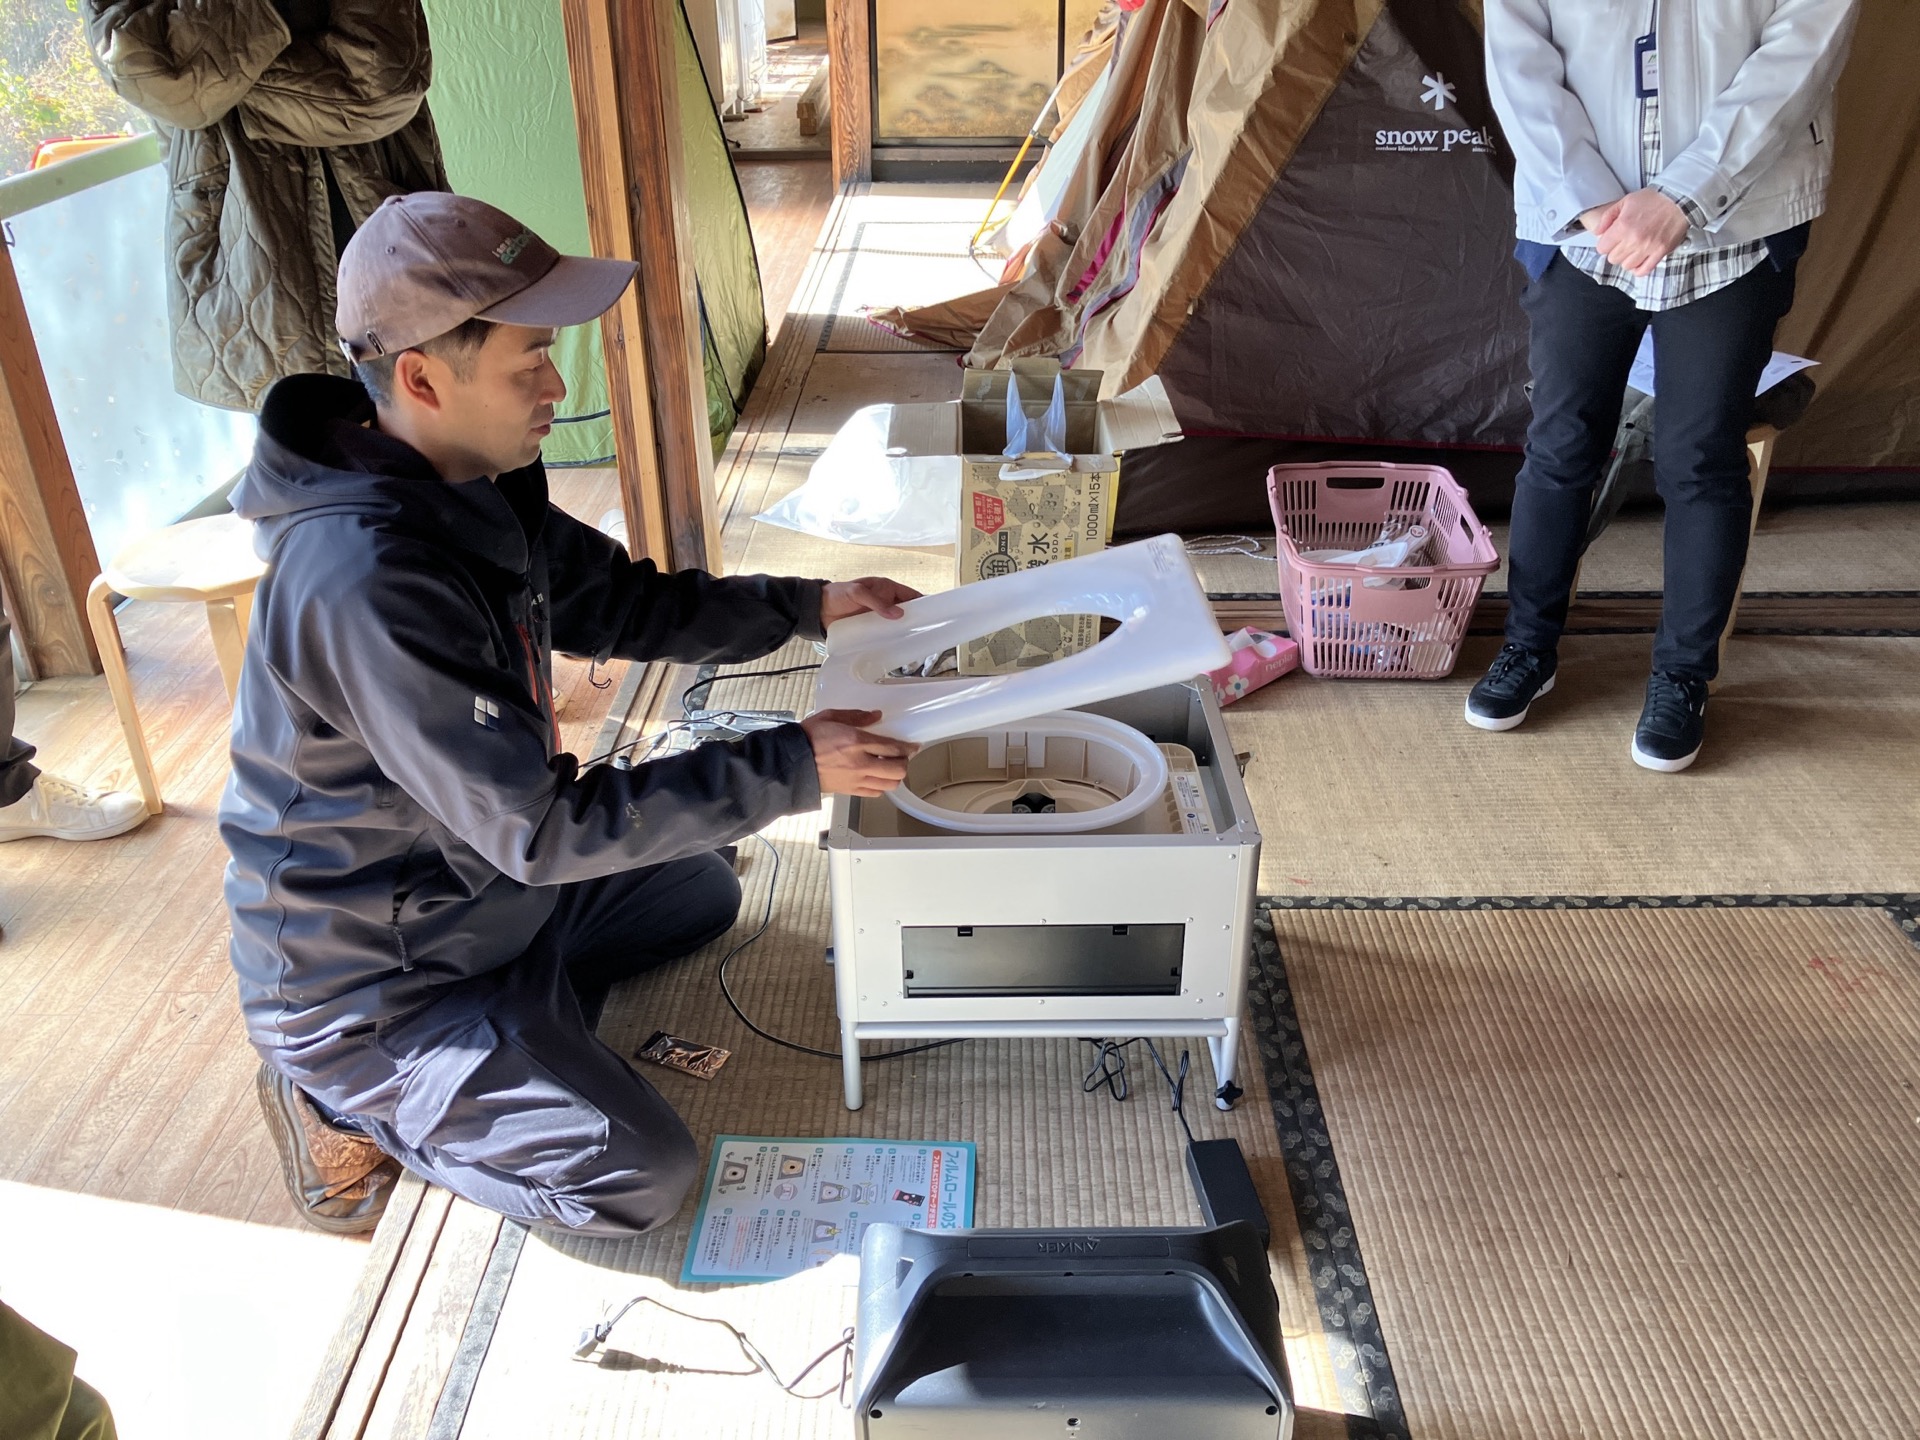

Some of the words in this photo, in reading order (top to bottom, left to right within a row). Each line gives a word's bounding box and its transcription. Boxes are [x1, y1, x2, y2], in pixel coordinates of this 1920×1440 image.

[1375, 129, 1438, 145] snow
[1442, 126, 1495, 152] peak
[1037, 1242, 1098, 1253] ANKER
